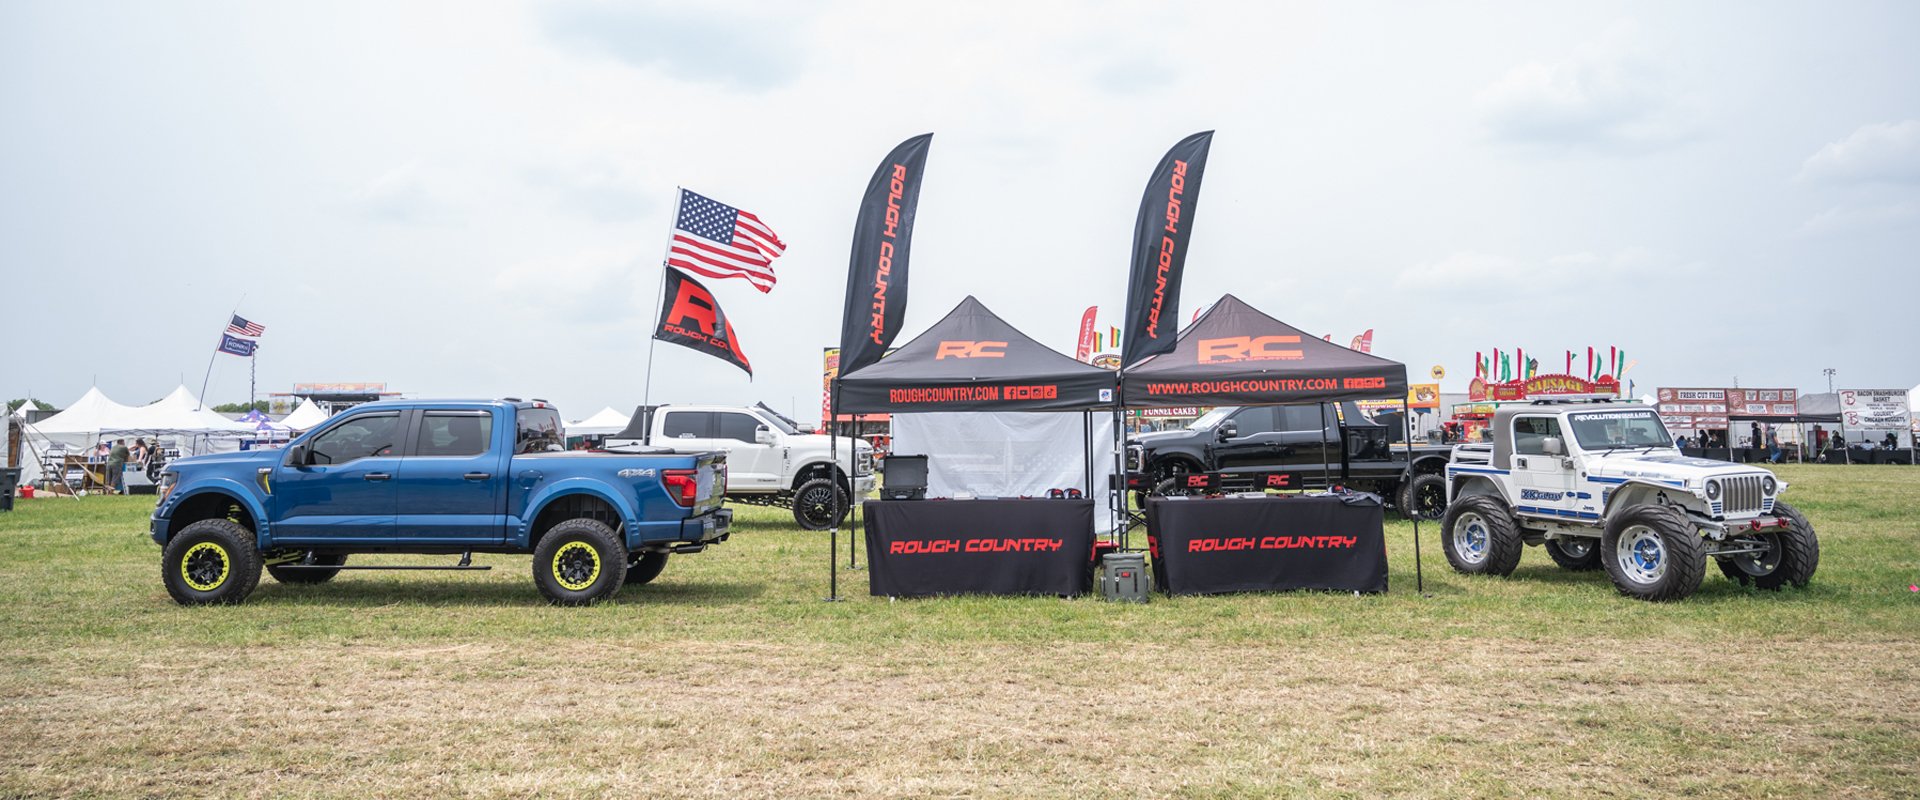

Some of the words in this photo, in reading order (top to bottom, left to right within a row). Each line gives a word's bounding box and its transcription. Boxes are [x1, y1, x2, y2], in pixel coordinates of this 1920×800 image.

[883, 163, 906, 238] ROUGH
[1165, 160, 1188, 234] ROUGH
[870, 240, 894, 345] COUNTRY
[1147, 236, 1175, 339] COUNTRY
[664, 324, 708, 343] ROUGH
[935, 341, 1009, 360] RC
[1198, 335, 1304, 360] RC
[1147, 377, 1338, 396] WWW.ROUGHCOUNTRY.COM
[1527, 377, 1584, 393] SAUSAGE
[889, 386, 999, 403] ROUGHCOUNTRY.COM
[1680, 391, 1697, 399] FRESH
[1697, 391, 1708, 399] CUT
[1709, 391, 1724, 399] FRIES
[1143, 407, 1172, 416] FUNNEL
[1173, 407, 1197, 415] CAKES
[1574, 413, 1621, 421] REVOLUTION
[1187, 475, 1209, 487] RC
[1267, 474, 1290, 486] RC
[889, 540, 960, 554] ROUGH
[965, 538, 1063, 553] COUNTRY
[1188, 537, 1256, 553] ROUGH
[1259, 536, 1358, 550] COUNTRY
